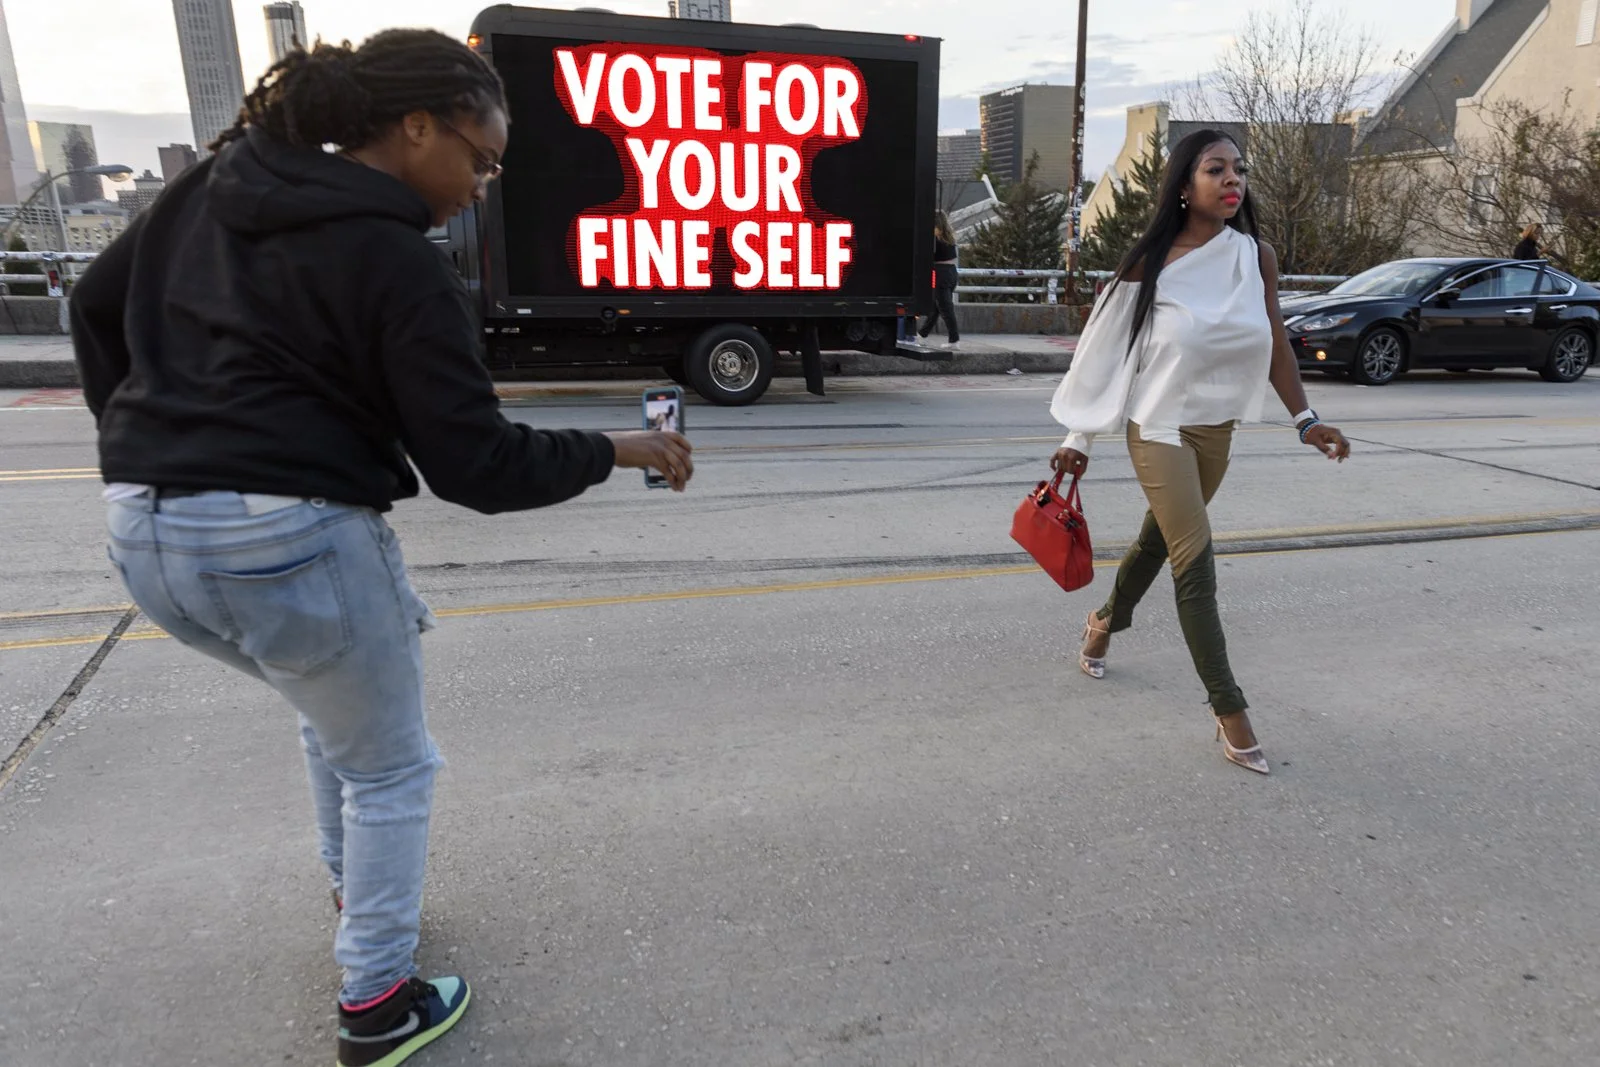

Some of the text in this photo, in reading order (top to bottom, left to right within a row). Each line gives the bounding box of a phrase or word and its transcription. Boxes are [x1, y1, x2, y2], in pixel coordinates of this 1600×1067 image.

[556, 50, 861, 137] VOTE FOR
[625, 138, 803, 212] YOUR
[579, 217, 852, 289] FINE SELF
